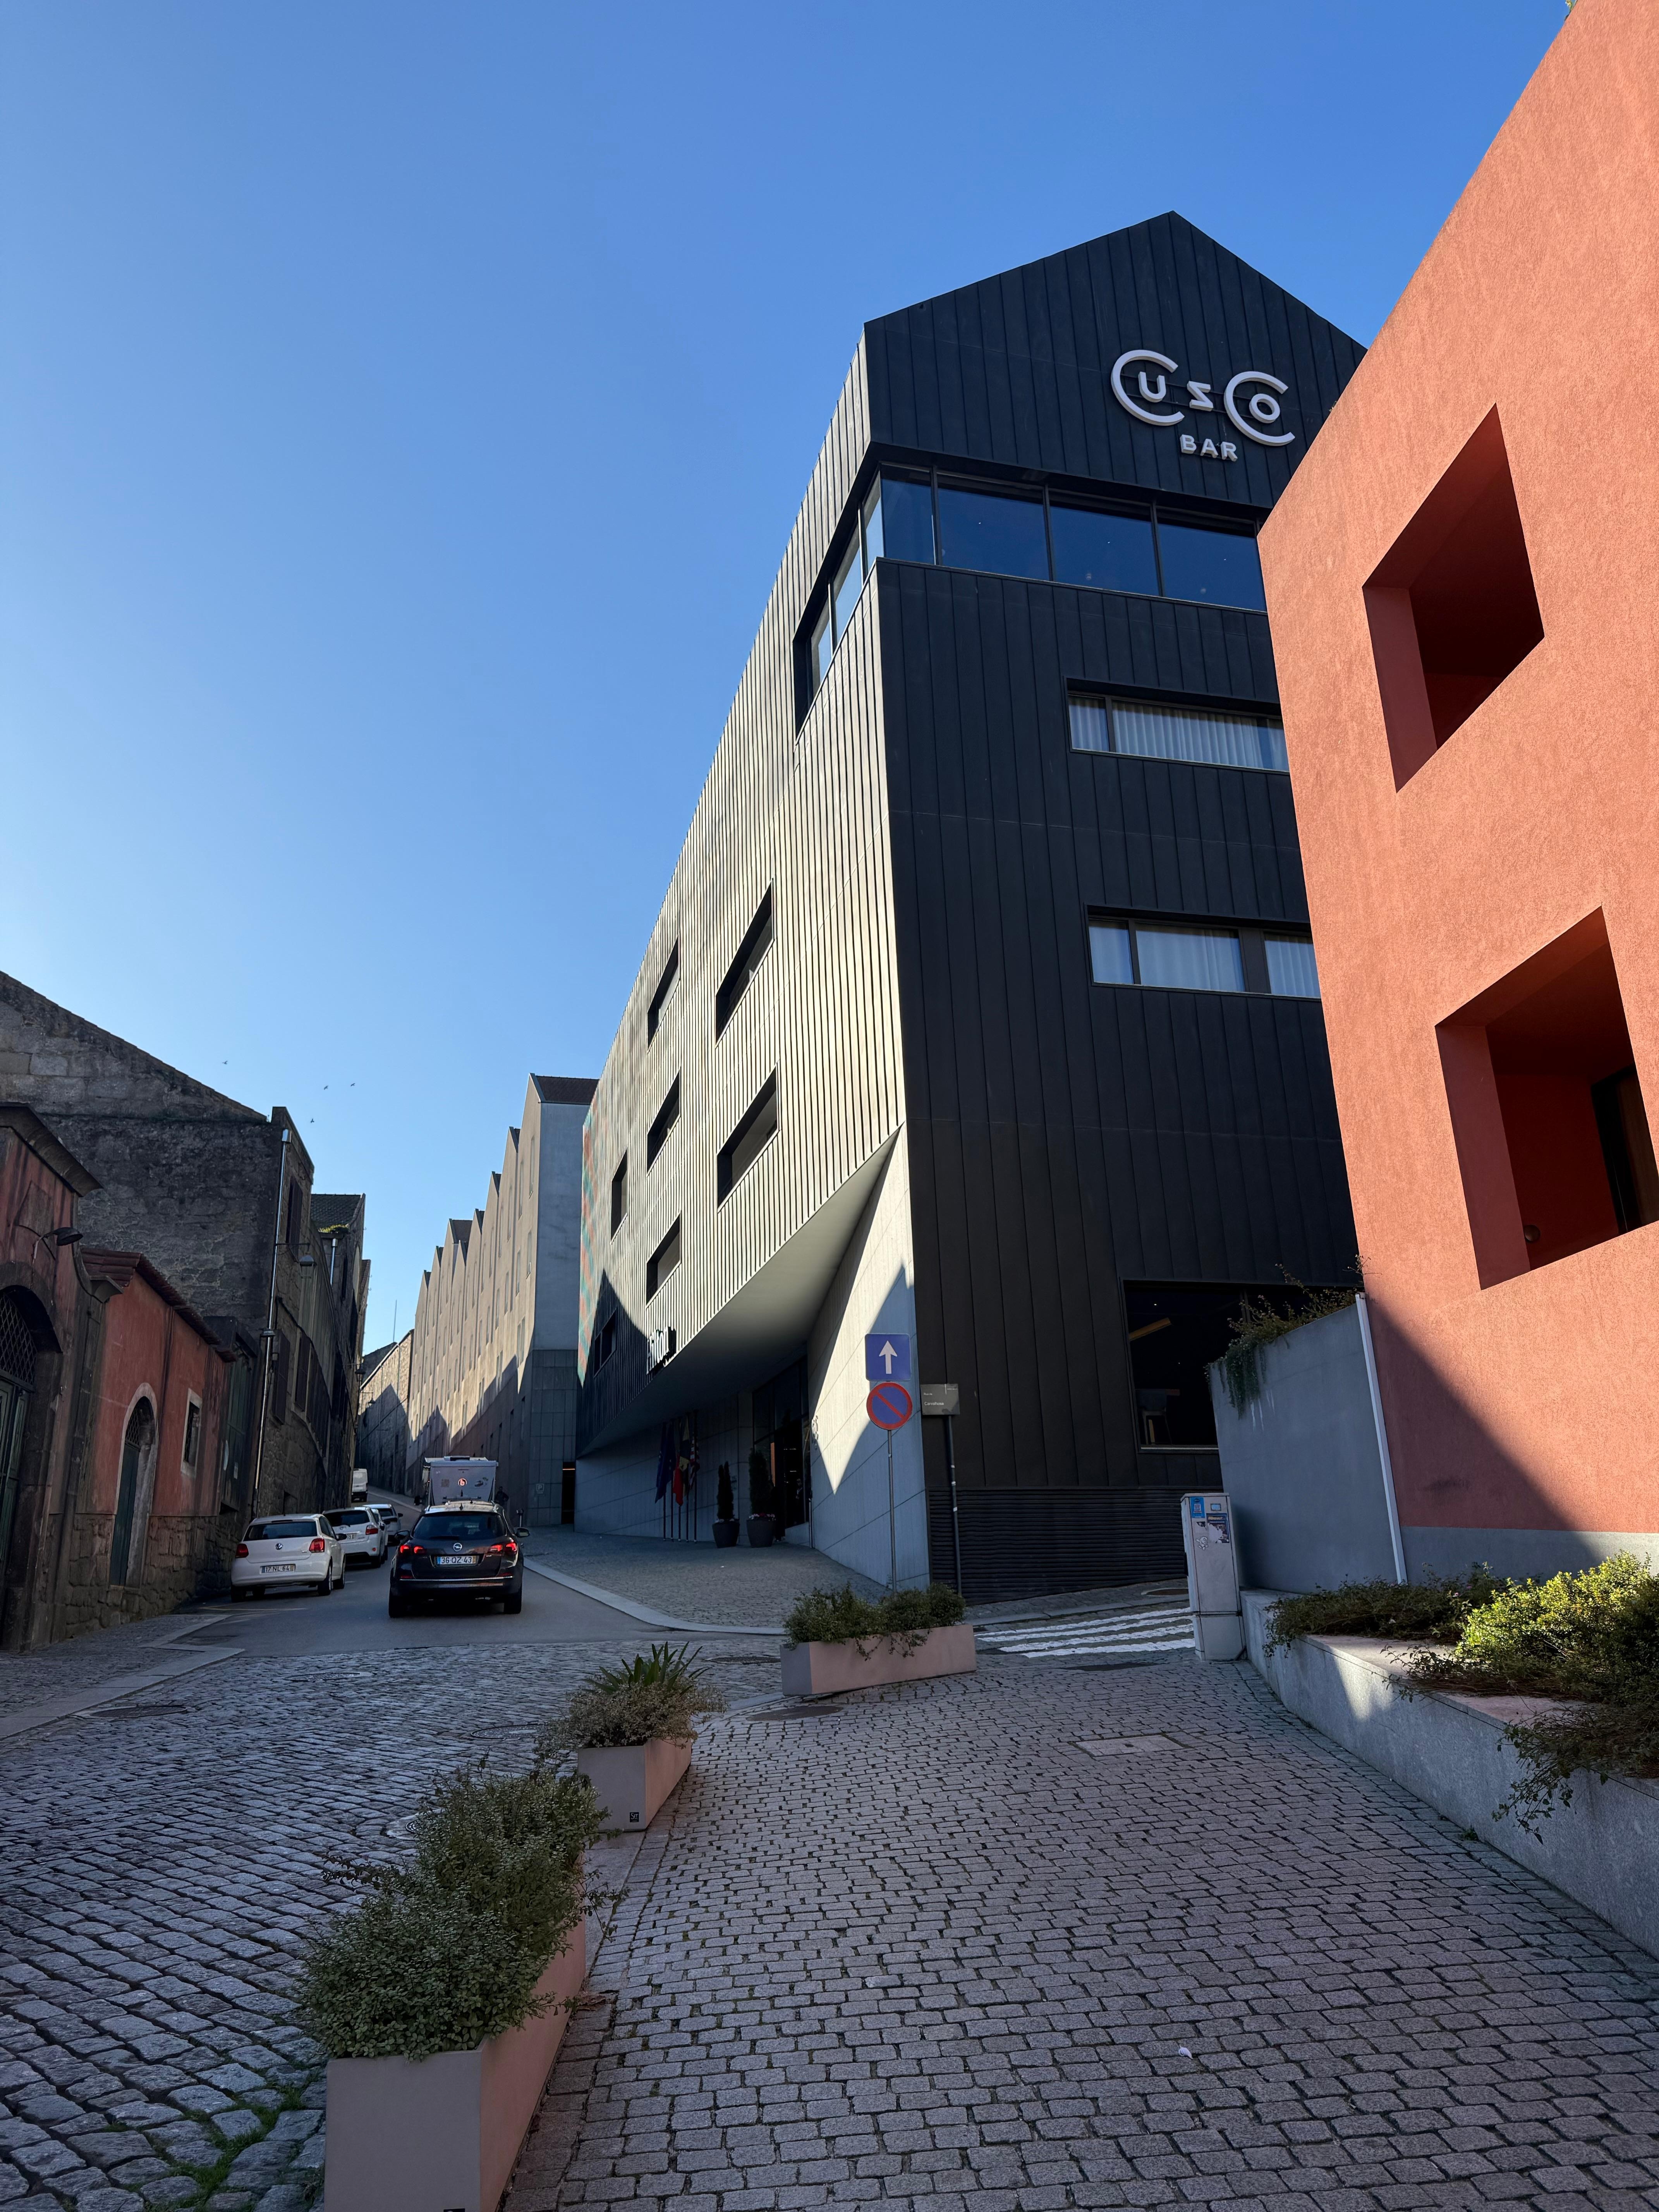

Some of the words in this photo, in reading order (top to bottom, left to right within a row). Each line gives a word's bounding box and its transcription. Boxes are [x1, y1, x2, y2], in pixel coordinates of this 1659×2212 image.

[1111, 349, 1295, 446] CUSCO
[1180, 434, 1238, 462] BAR
[646, 1326, 669, 1375] Hilton
